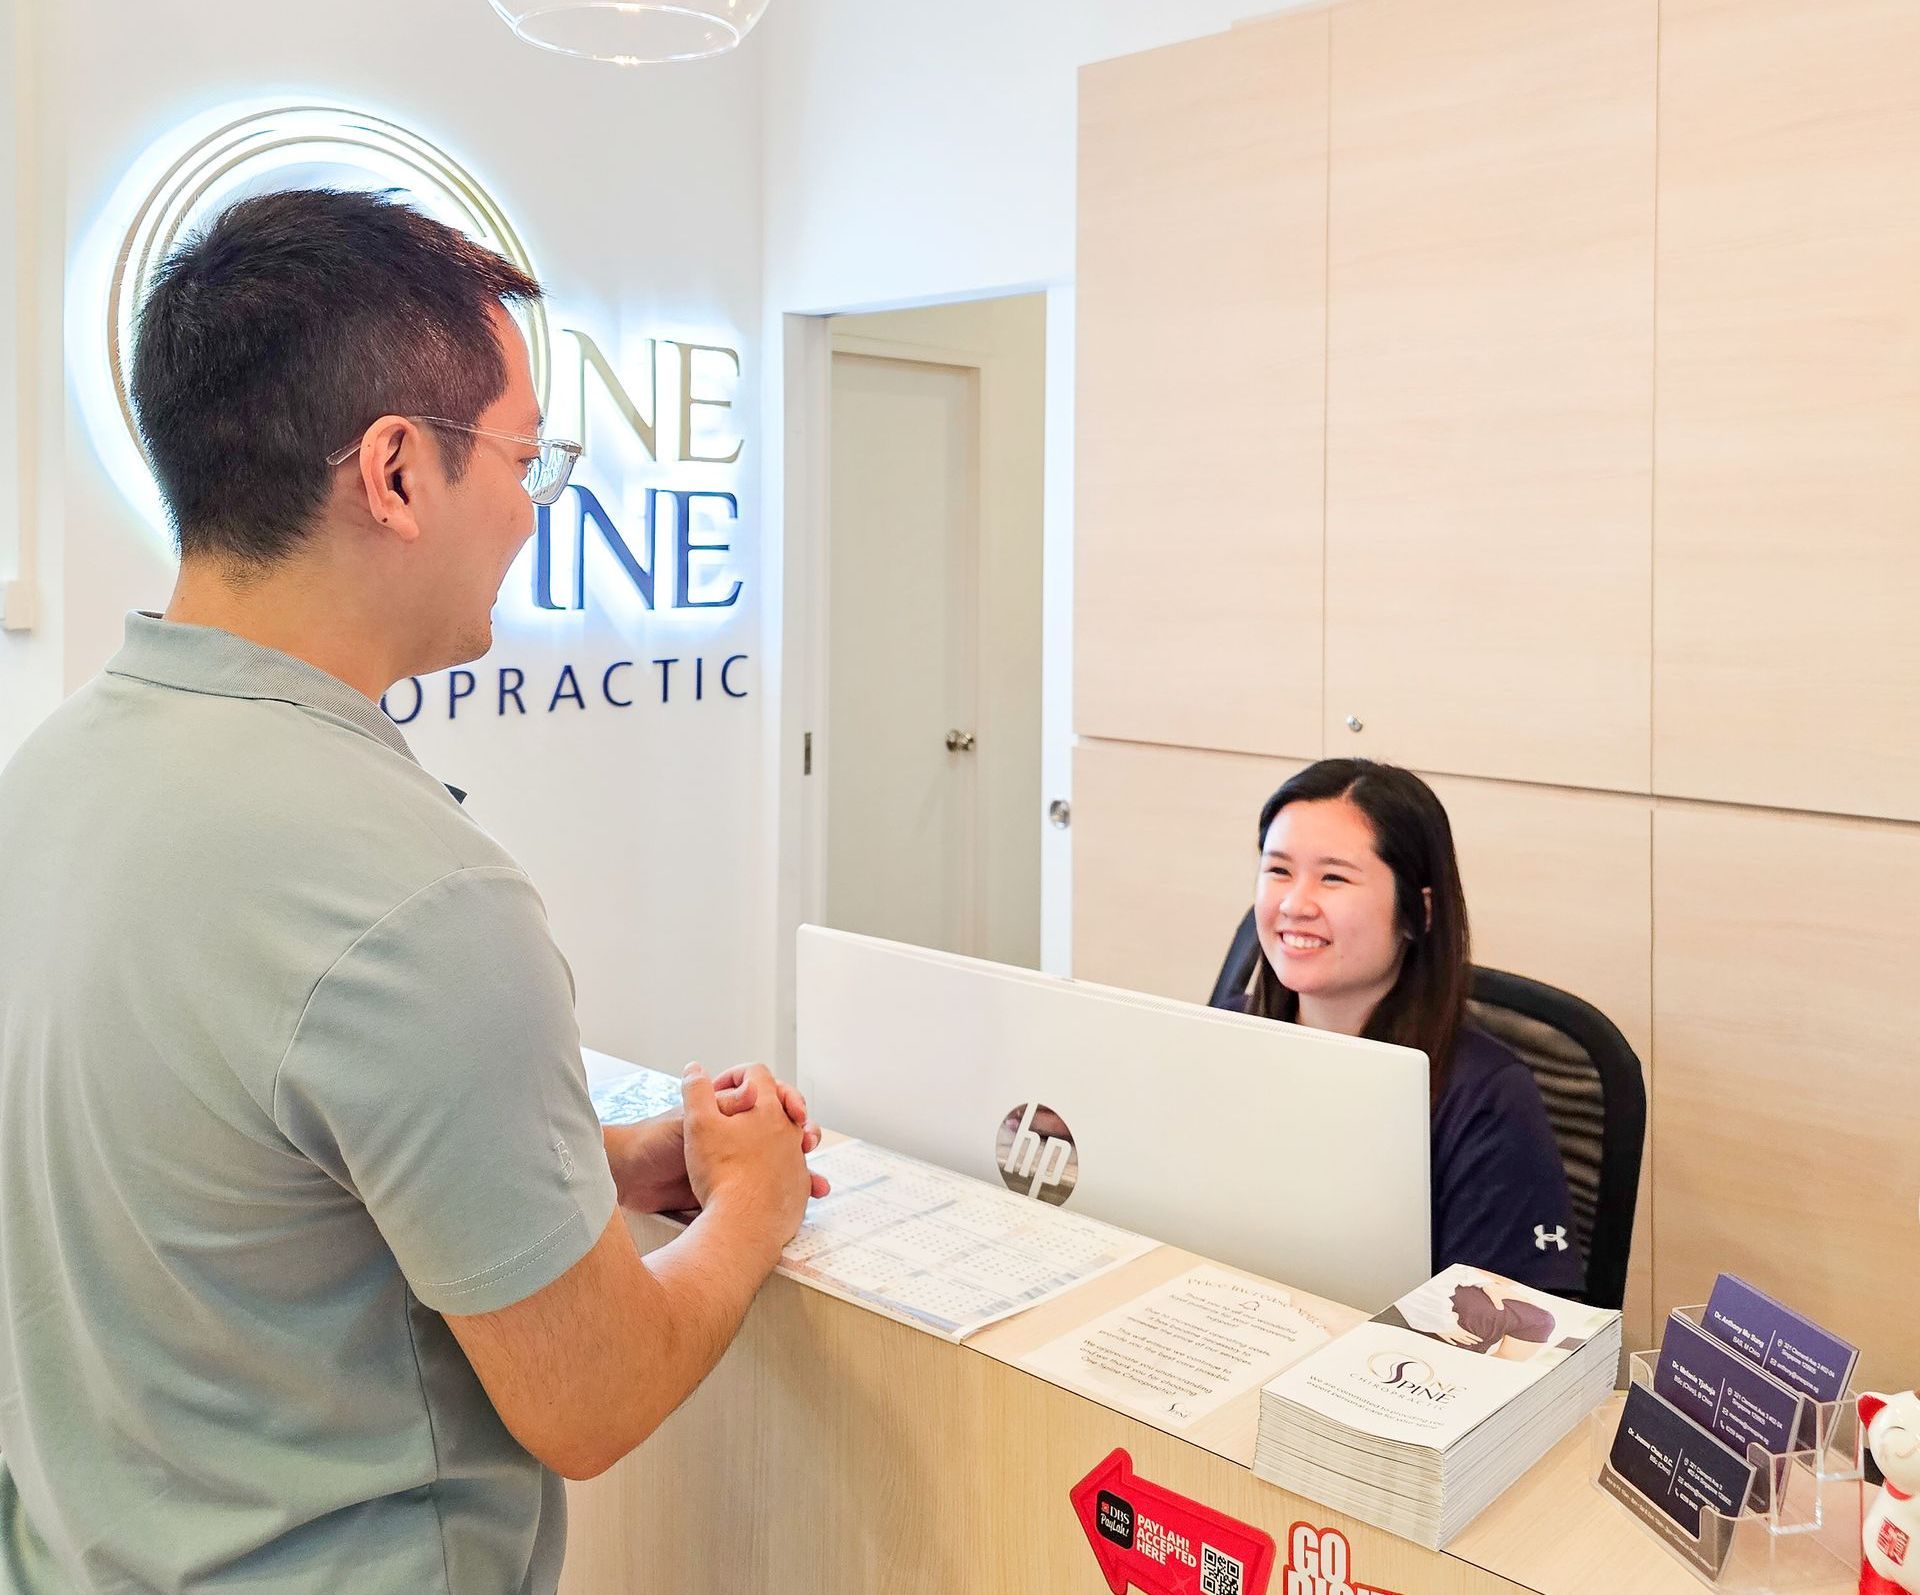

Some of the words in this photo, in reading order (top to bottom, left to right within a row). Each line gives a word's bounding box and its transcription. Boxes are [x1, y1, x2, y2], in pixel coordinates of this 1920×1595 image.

[531, 484, 744, 610] INE
[380, 655, 748, 725] OPRACTIC
[1003, 1102, 1072, 1199] hp
[1350, 1372, 1444, 1411] CHIROPRACTIC
[1382, 1361, 1456, 1404] SPINE
[1100, 1512, 1130, 1537] PayLah!
[1110, 1505, 1130, 1525] DBS
[1137, 1513, 1190, 1552] PAYLAH!
[1136, 1527, 1197, 1568] ACCEPTED
[1136, 1538, 1166, 1566] HERE
[1292, 1525, 1347, 1583] GO
